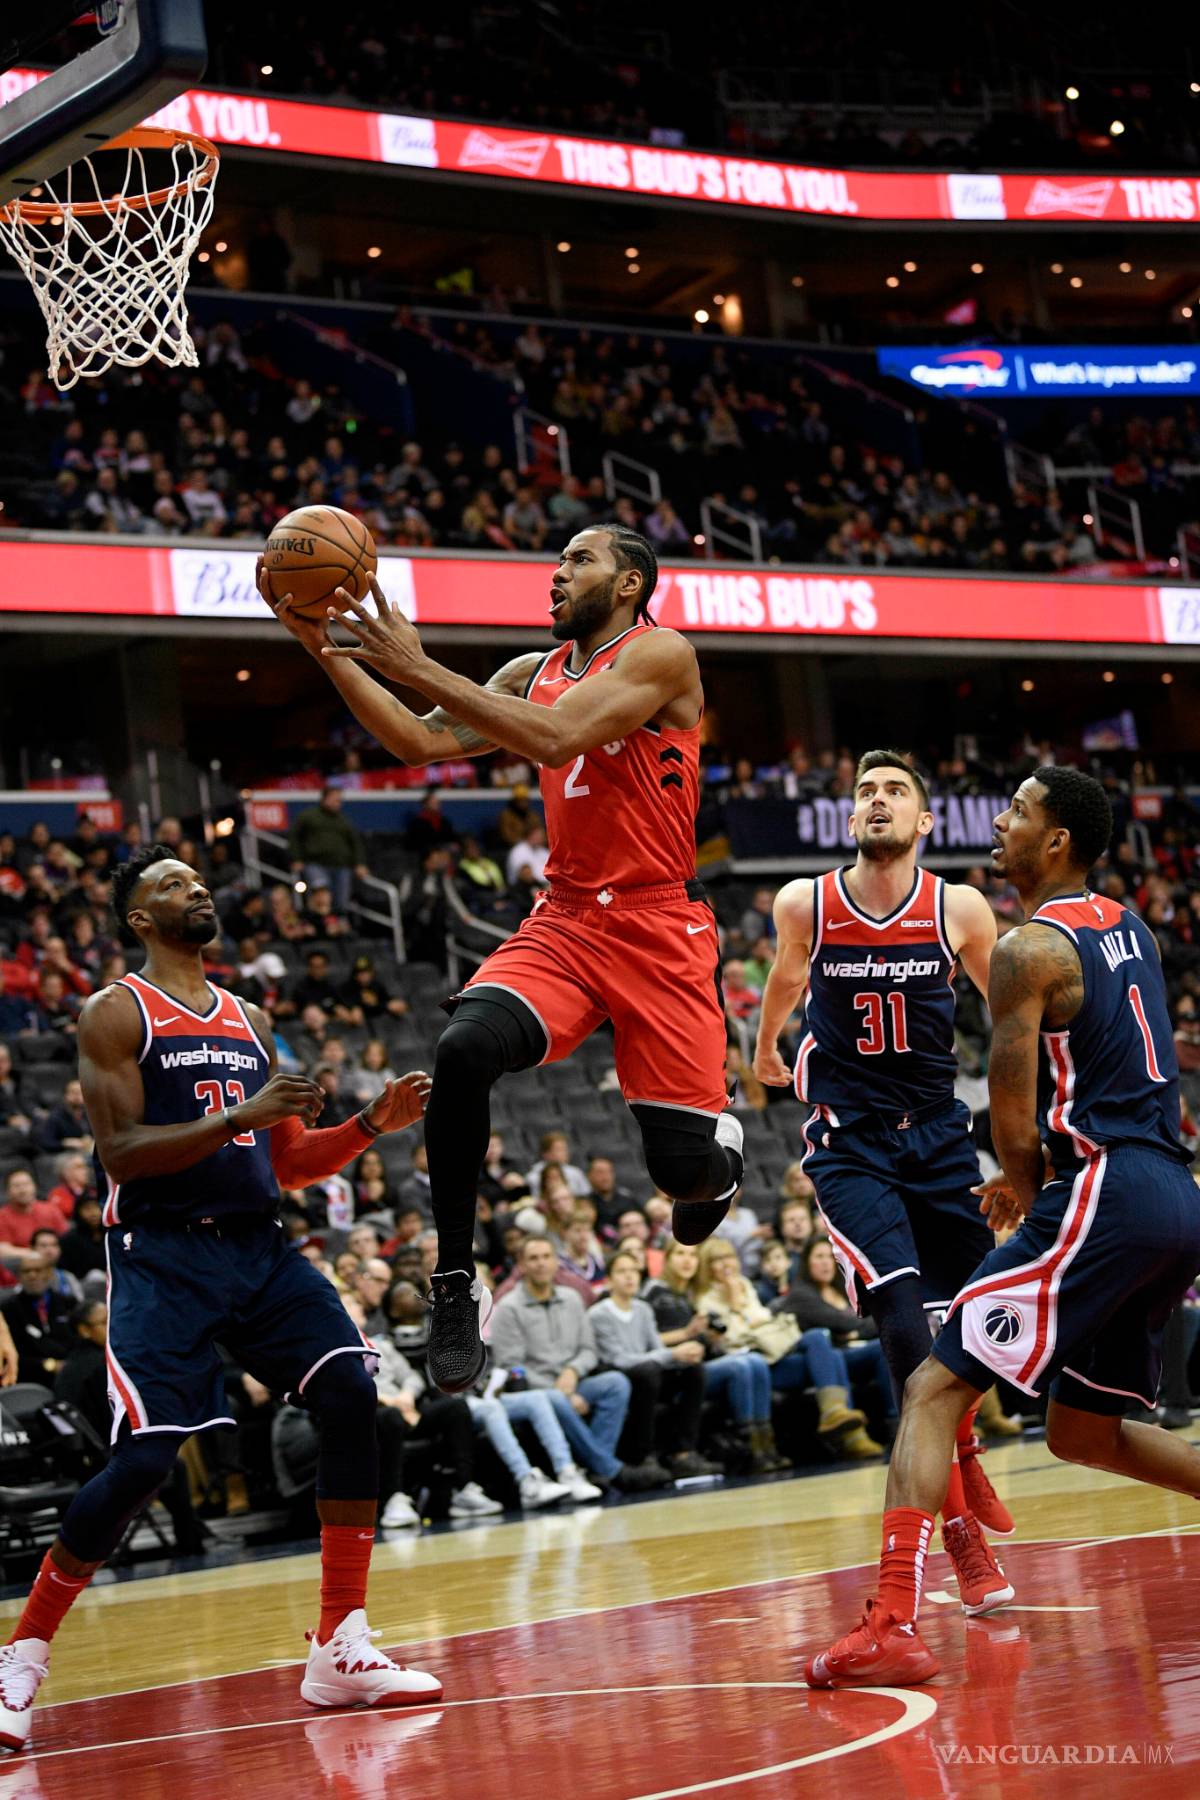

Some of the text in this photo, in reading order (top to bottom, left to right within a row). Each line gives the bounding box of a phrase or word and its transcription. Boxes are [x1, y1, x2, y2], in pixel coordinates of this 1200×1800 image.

[194, 94, 281, 145] YOU.
[554, 139, 630, 188] THIS
[631, 149, 726, 199] BUD'S
[725, 160, 785, 205] FOR
[784, 168, 858, 213] YOU.
[1119, 180, 1195, 219] THIS
[675, 573, 878, 630] THIS BUD'S
[564, 754, 590, 799] 2
[901, 920, 933, 928] GEICO
[823, 954, 940, 983] washington
[854, 992, 912, 1055] 31
[1129, 984, 1169, 1082] 1
[160, 1042, 258, 1071] washington
